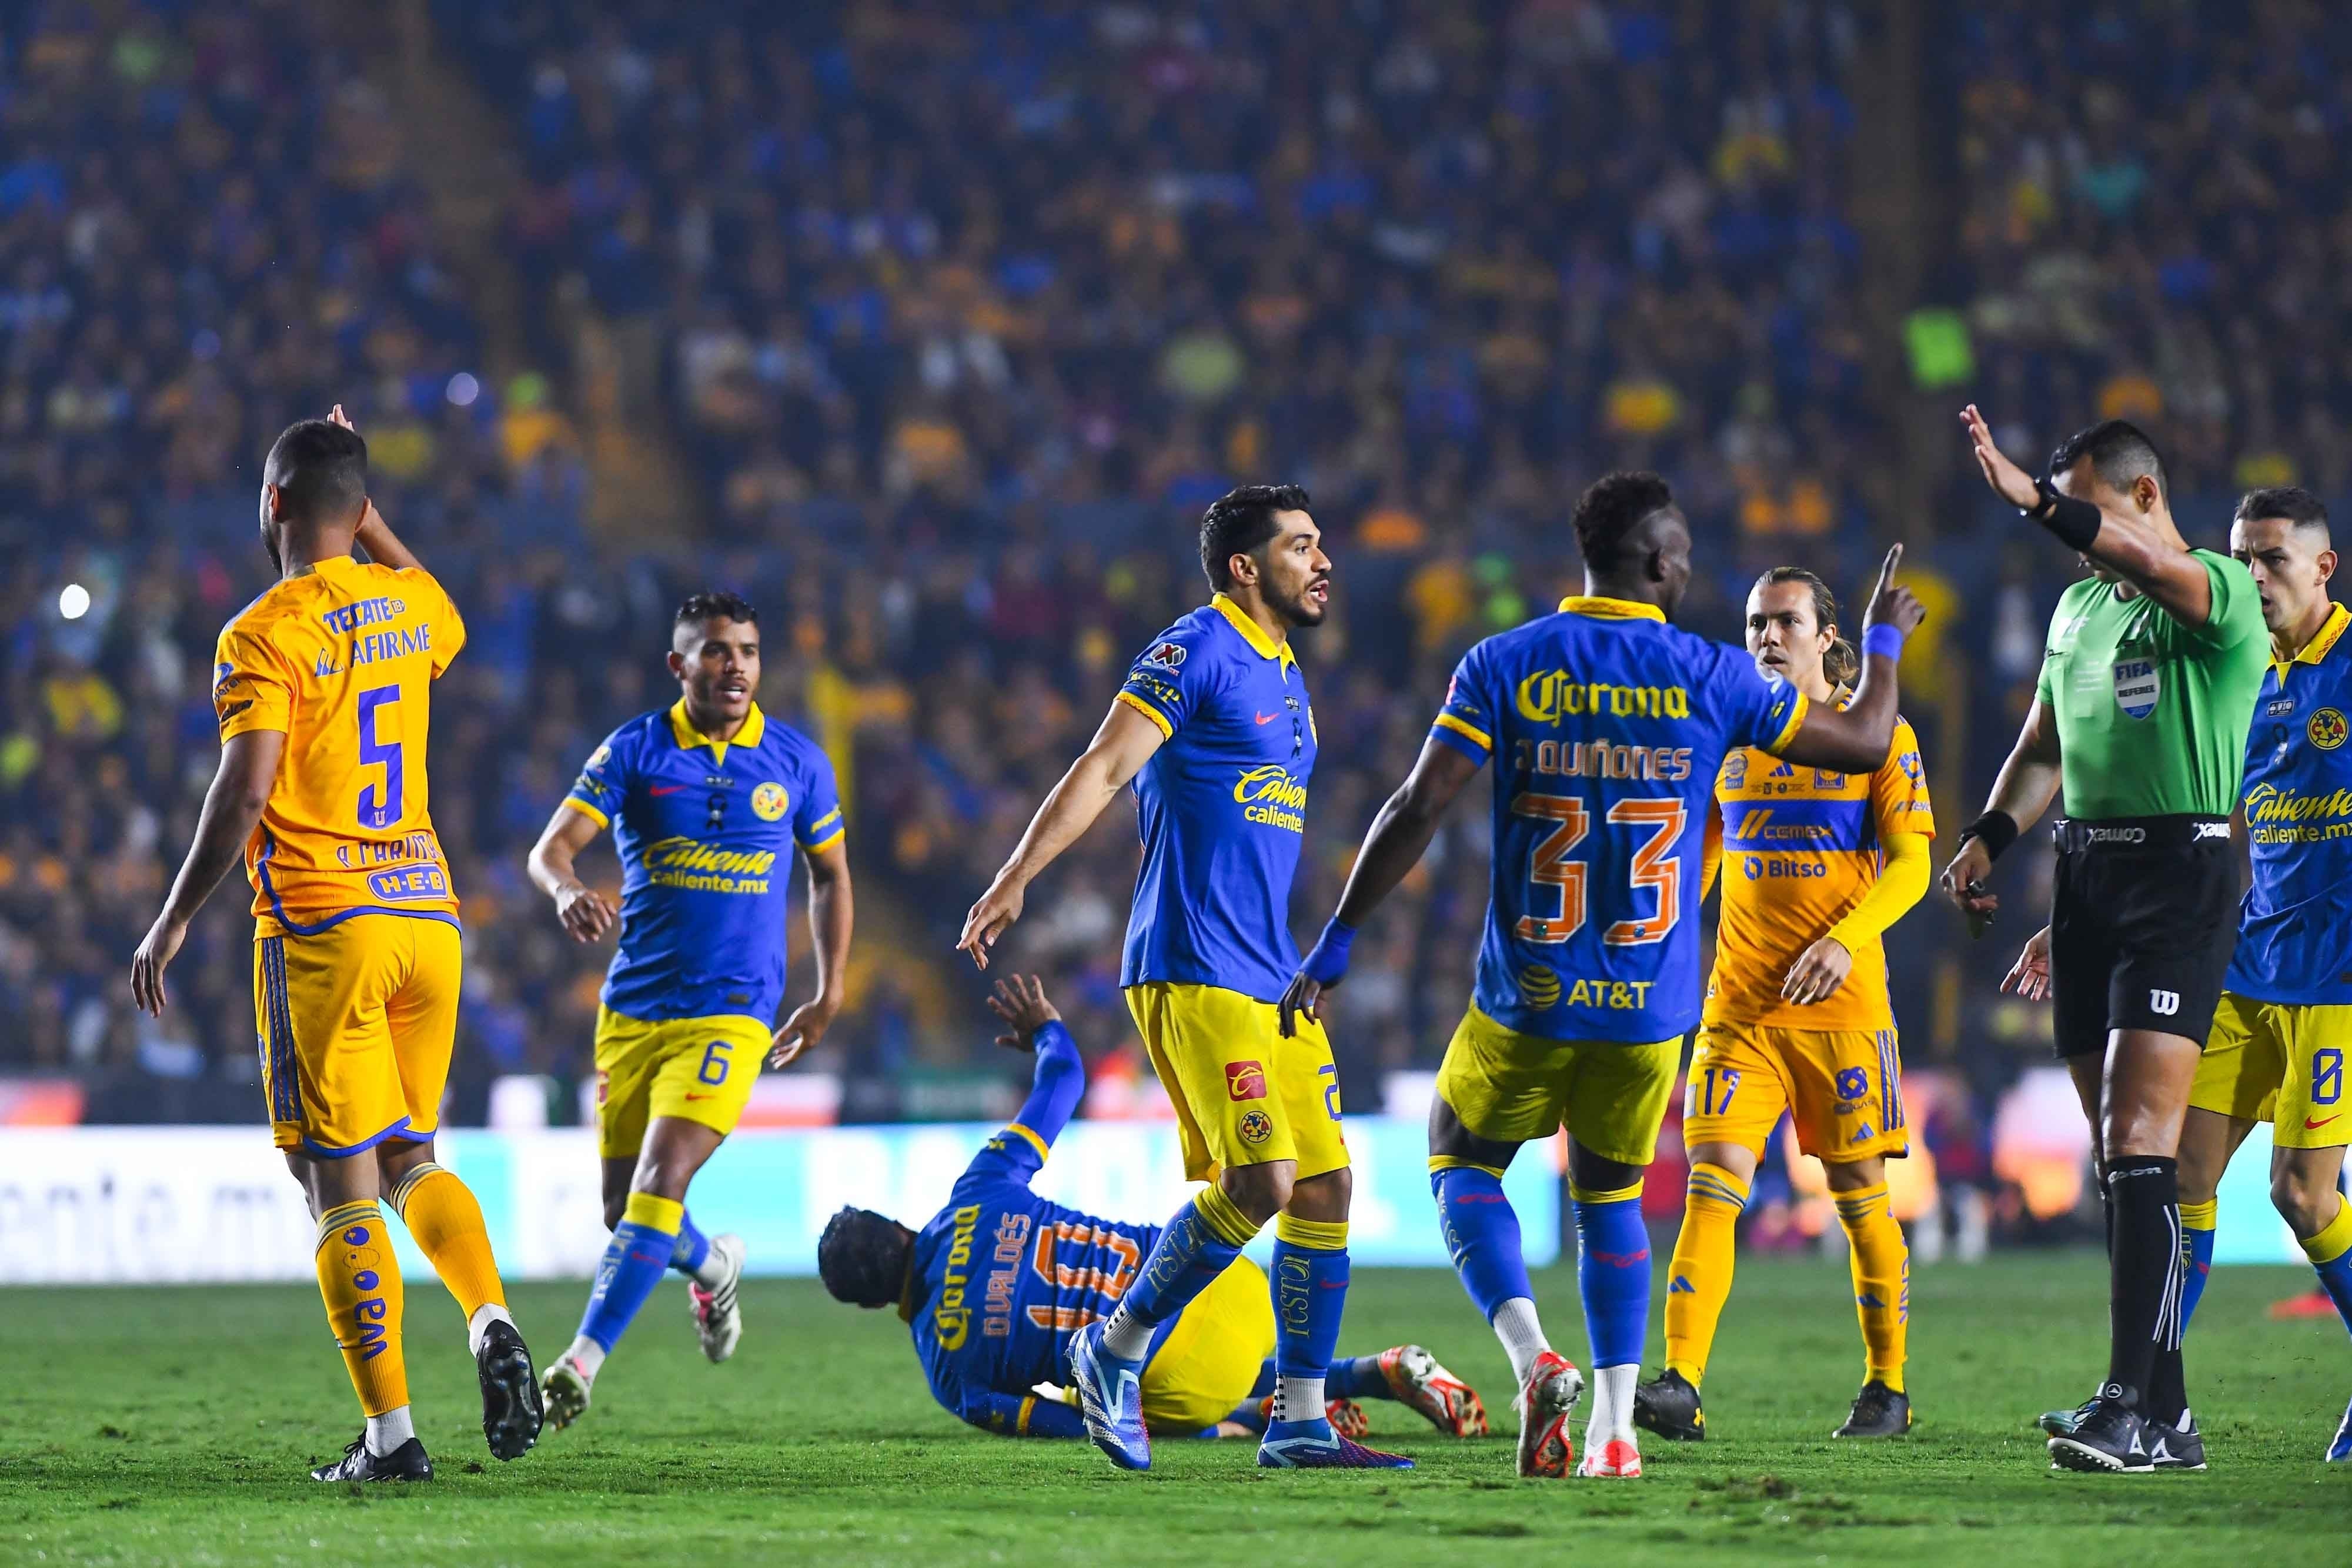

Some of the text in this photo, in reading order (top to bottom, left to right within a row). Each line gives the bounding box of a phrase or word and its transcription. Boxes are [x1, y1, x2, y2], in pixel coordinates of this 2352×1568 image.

[323, 597, 393, 634] TECATE
[351, 624, 430, 668] AFIRME
[2114, 661, 2154, 680] FIFA
[1516, 667, 1690, 727] Corona
[358, 684, 404, 829] 5
[1763, 825, 1834, 840] cemex
[2086, 827, 2146, 845] Comex
[642, 835, 776, 875] Caliente
[1512, 791, 1688, 946] 33
[1768, 859, 1826, 877] Bitso
[651, 870, 769, 894] caliente.mx
[1567, 979, 1655, 1009] AT&T
[699, 1040, 733, 1086] 6
[1705, 1068, 1740, 1115] 17
[935, 1204, 981, 1352] Corona
[1027, 1220, 1143, 1332] 10
